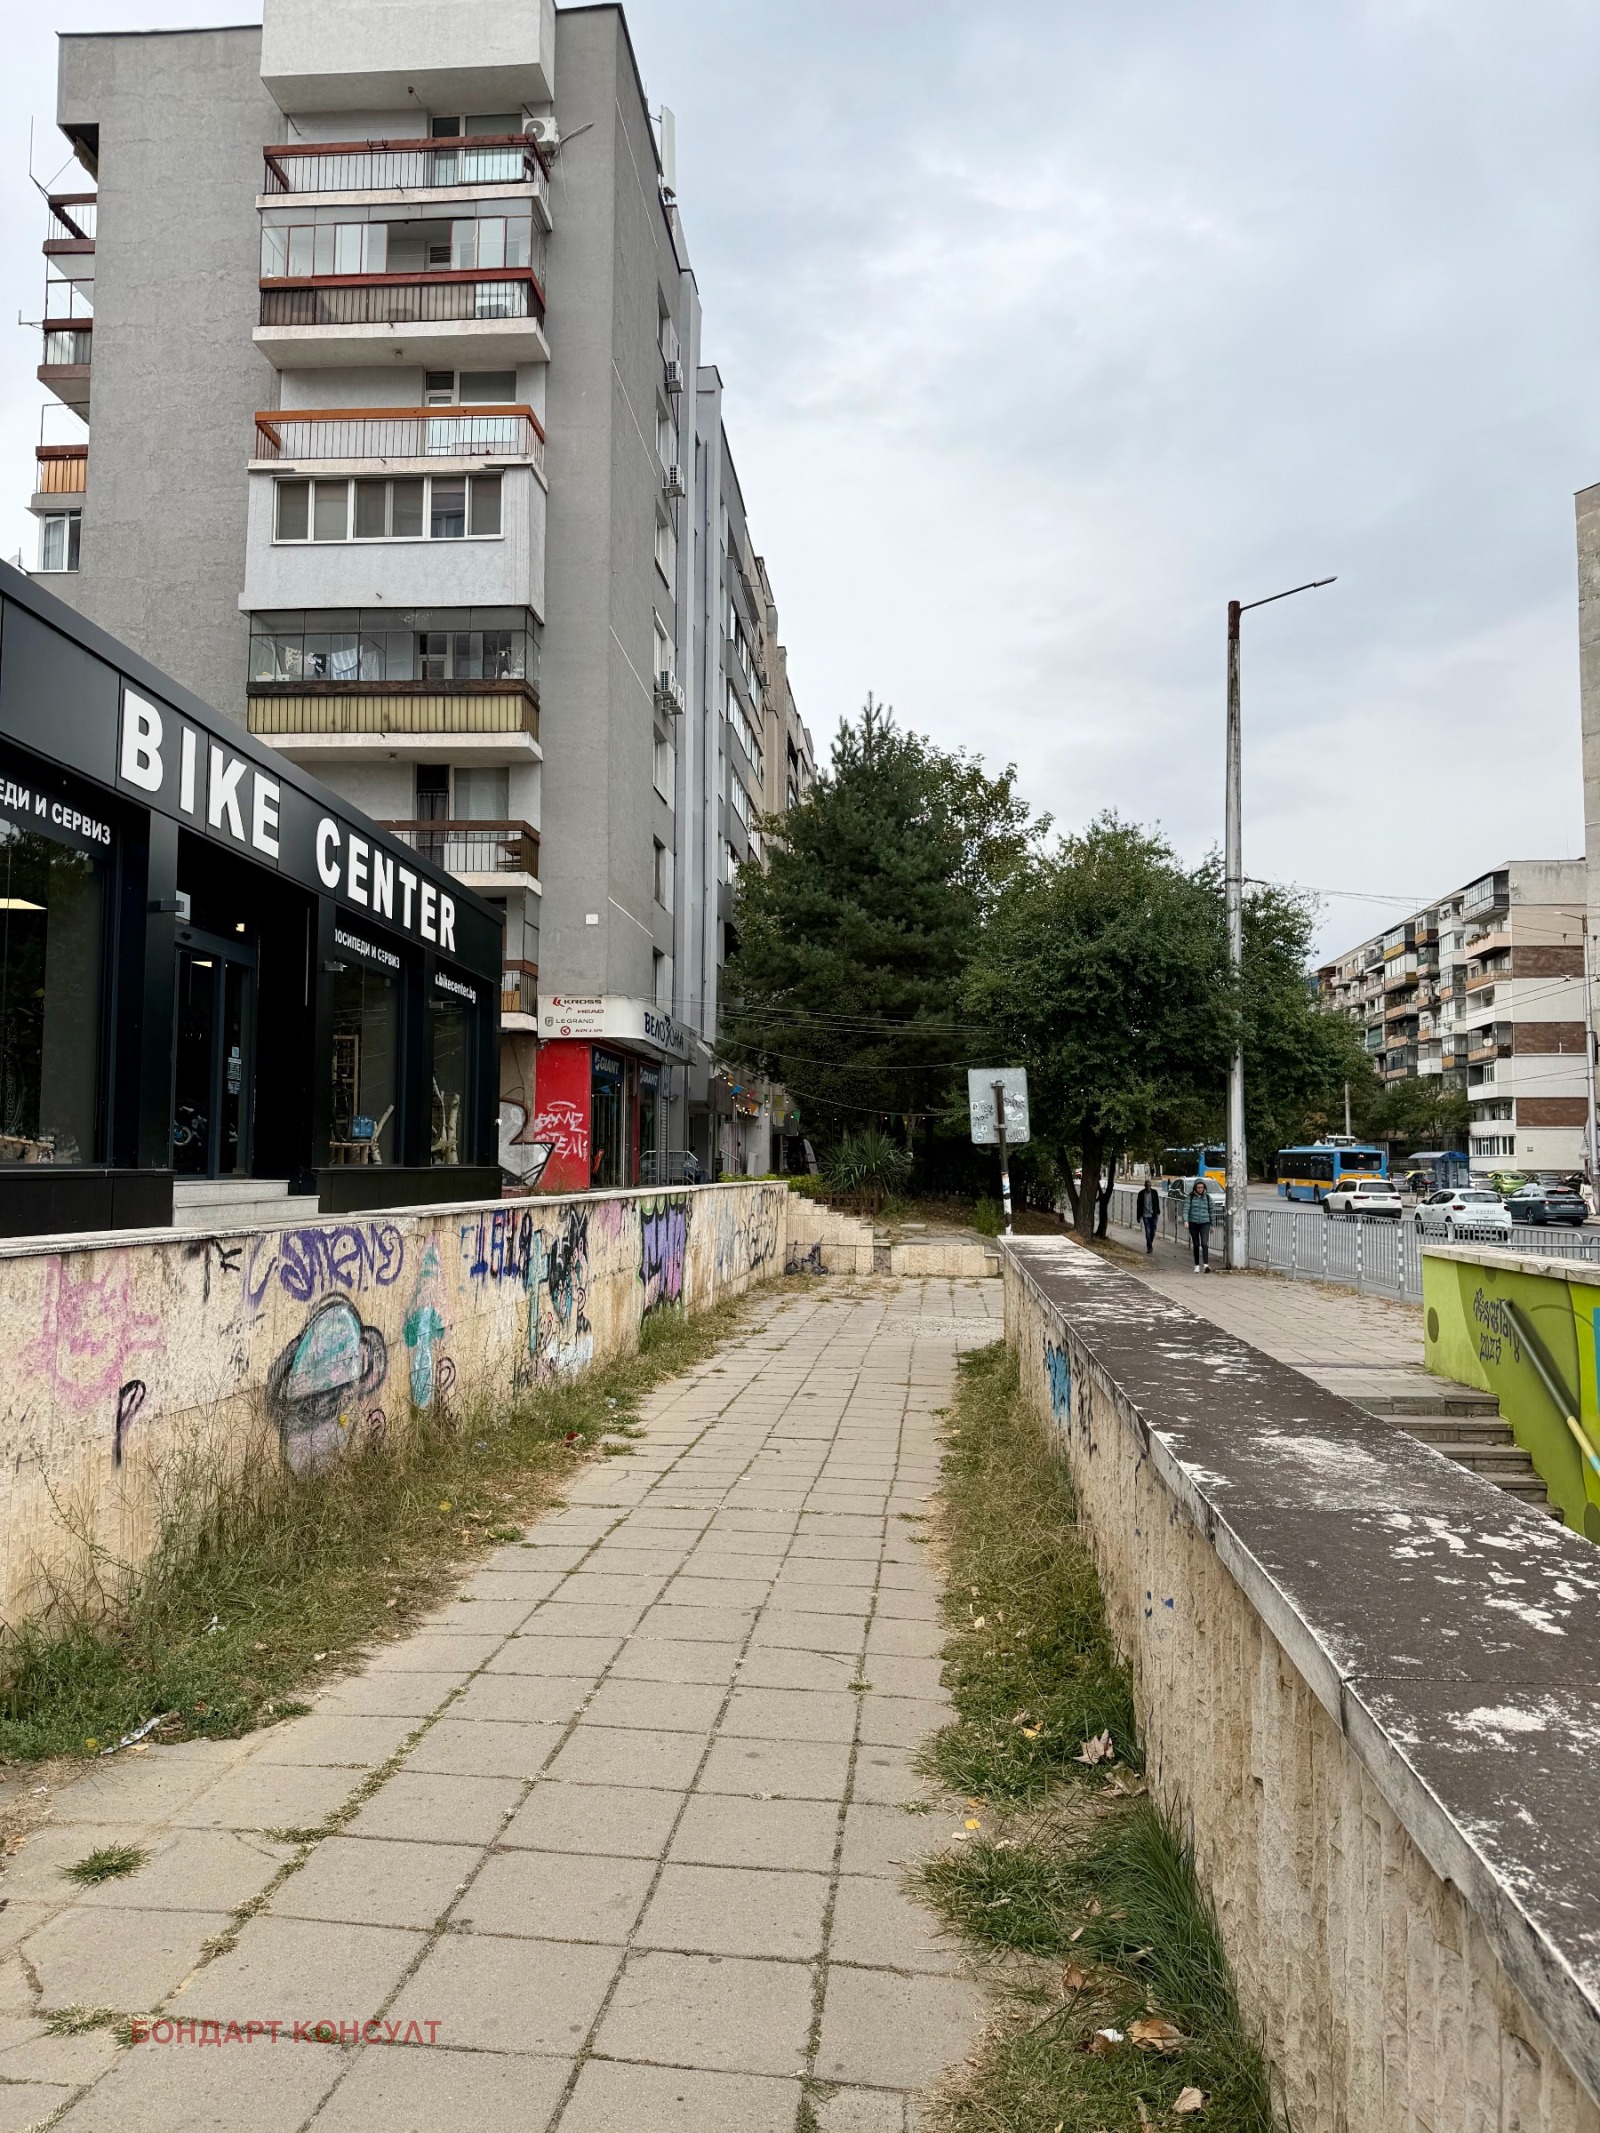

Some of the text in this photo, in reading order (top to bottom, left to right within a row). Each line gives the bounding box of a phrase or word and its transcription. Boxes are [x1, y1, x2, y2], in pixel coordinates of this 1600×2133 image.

[35, 794, 47, 818] И
[52, 803, 111, 845] СЕРВИЗ
[119, 687, 457, 954] BIKE CENTER
[377, 949, 400, 969] СЕРВИЗ
[600, 1056, 620, 1075] GIANT
